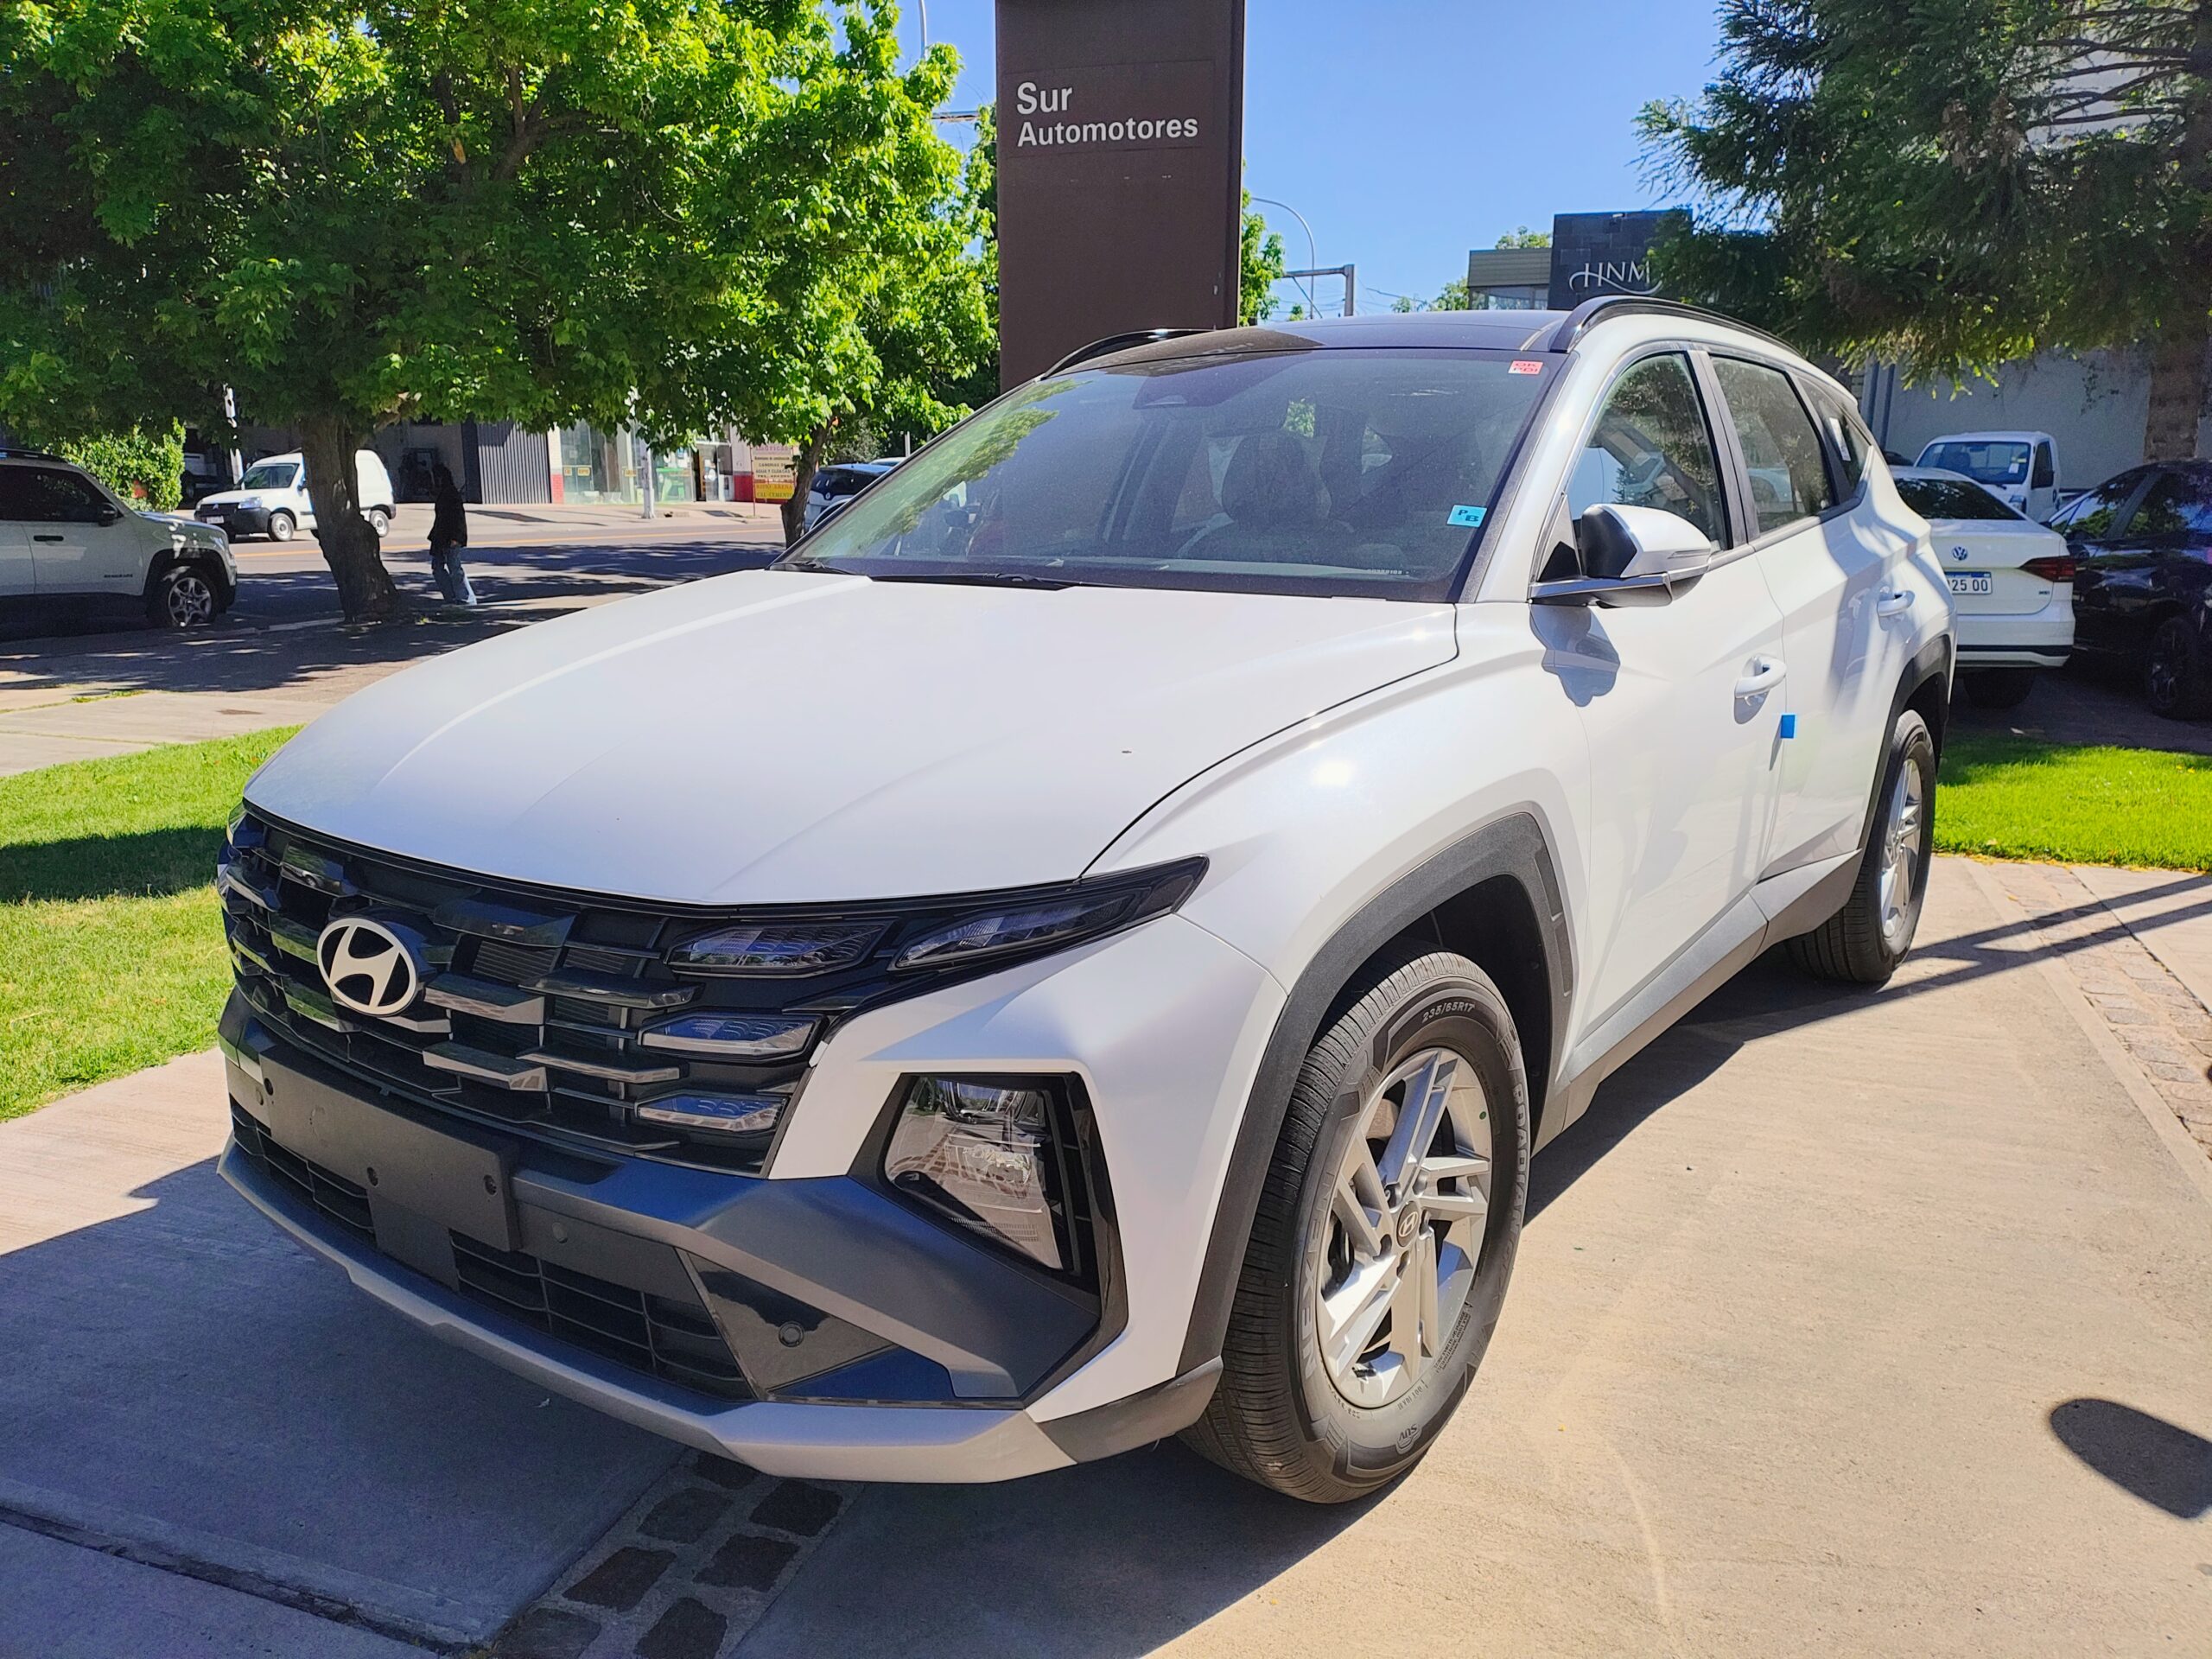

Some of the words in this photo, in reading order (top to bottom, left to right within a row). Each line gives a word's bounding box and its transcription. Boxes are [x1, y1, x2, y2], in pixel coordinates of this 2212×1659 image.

[1016, 81, 1073, 114] Sur
[1017, 117, 1199, 147] Automotores
[1510, 1083, 1528, 1238] ROADIAN
[1301, 1170, 1337, 1380] NEXEN
[1398, 1423, 1418, 1442] SUV
